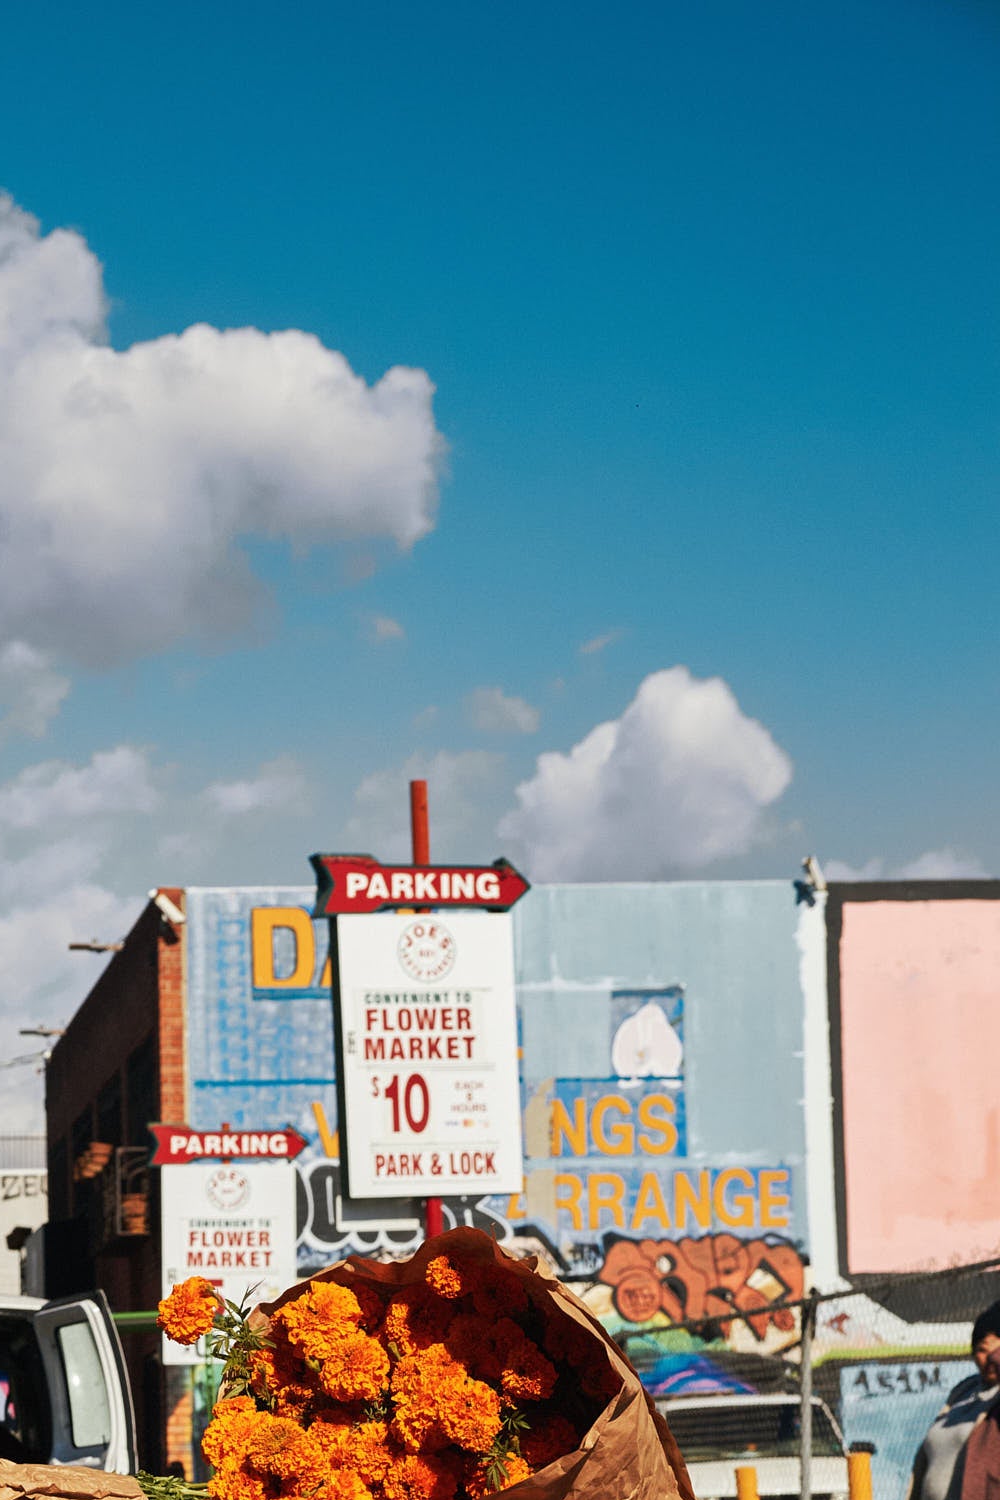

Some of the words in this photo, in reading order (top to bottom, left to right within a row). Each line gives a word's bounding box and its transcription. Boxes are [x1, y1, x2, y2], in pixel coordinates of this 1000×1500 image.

[346, 871, 500, 900] PARKING
[364, 993, 450, 1005] CONVENIENT
[456, 992, 472, 1004] TO
[366, 1008, 471, 1032] FLOWER
[364, 1036, 475, 1060] MARKET
[169, 1134, 288, 1155] PARKING
[375, 1154, 424, 1176] PARK
[431, 1153, 443, 1175] &
[450, 1152, 497, 1174] LOCK
[189, 1231, 270, 1247] FLOWER
[187, 1251, 273, 1267] MARKET
